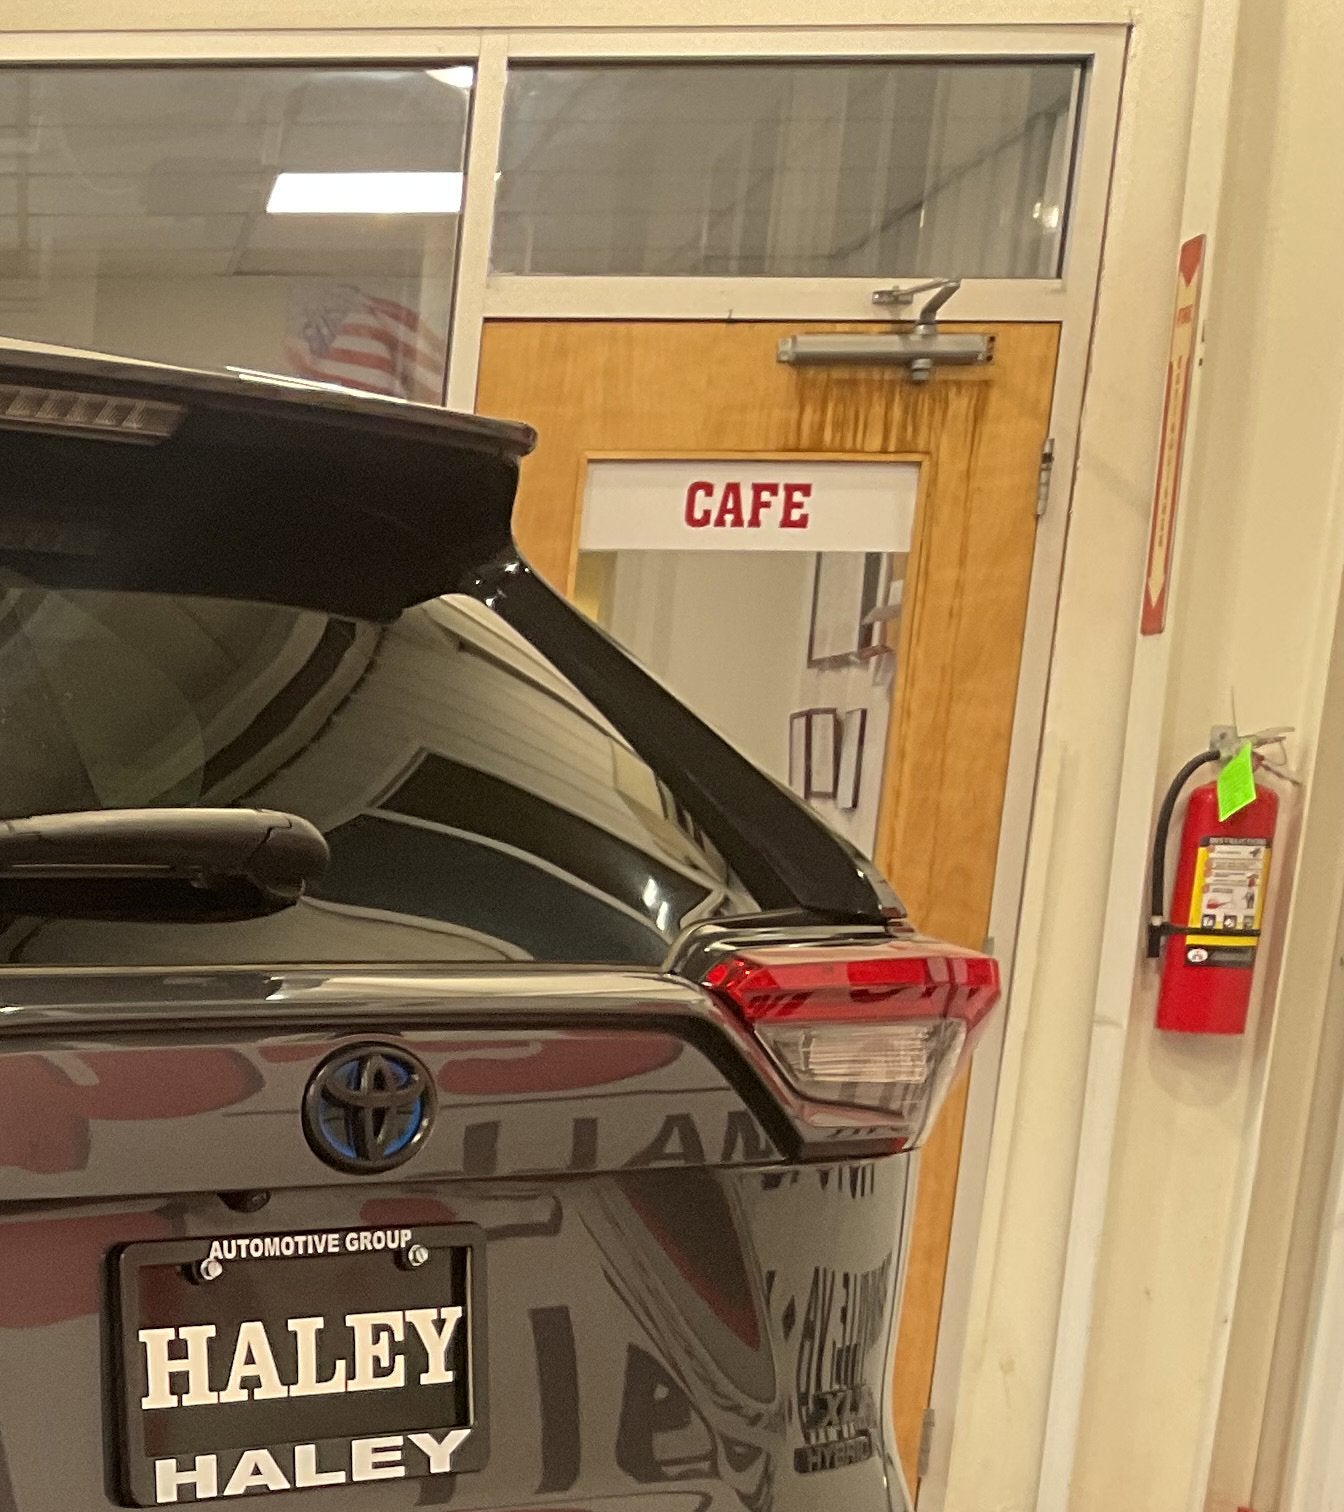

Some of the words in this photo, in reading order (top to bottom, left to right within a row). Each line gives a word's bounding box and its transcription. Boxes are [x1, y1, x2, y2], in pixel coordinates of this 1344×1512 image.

[685, 481, 812, 529] CAFE
[209, 1234, 339, 1260] AUTOMOTIVE
[345, 1229, 412, 1251] GROUP
[138, 1306, 462, 1410] HALEY
[155, 1429, 471, 1503] HALEY
